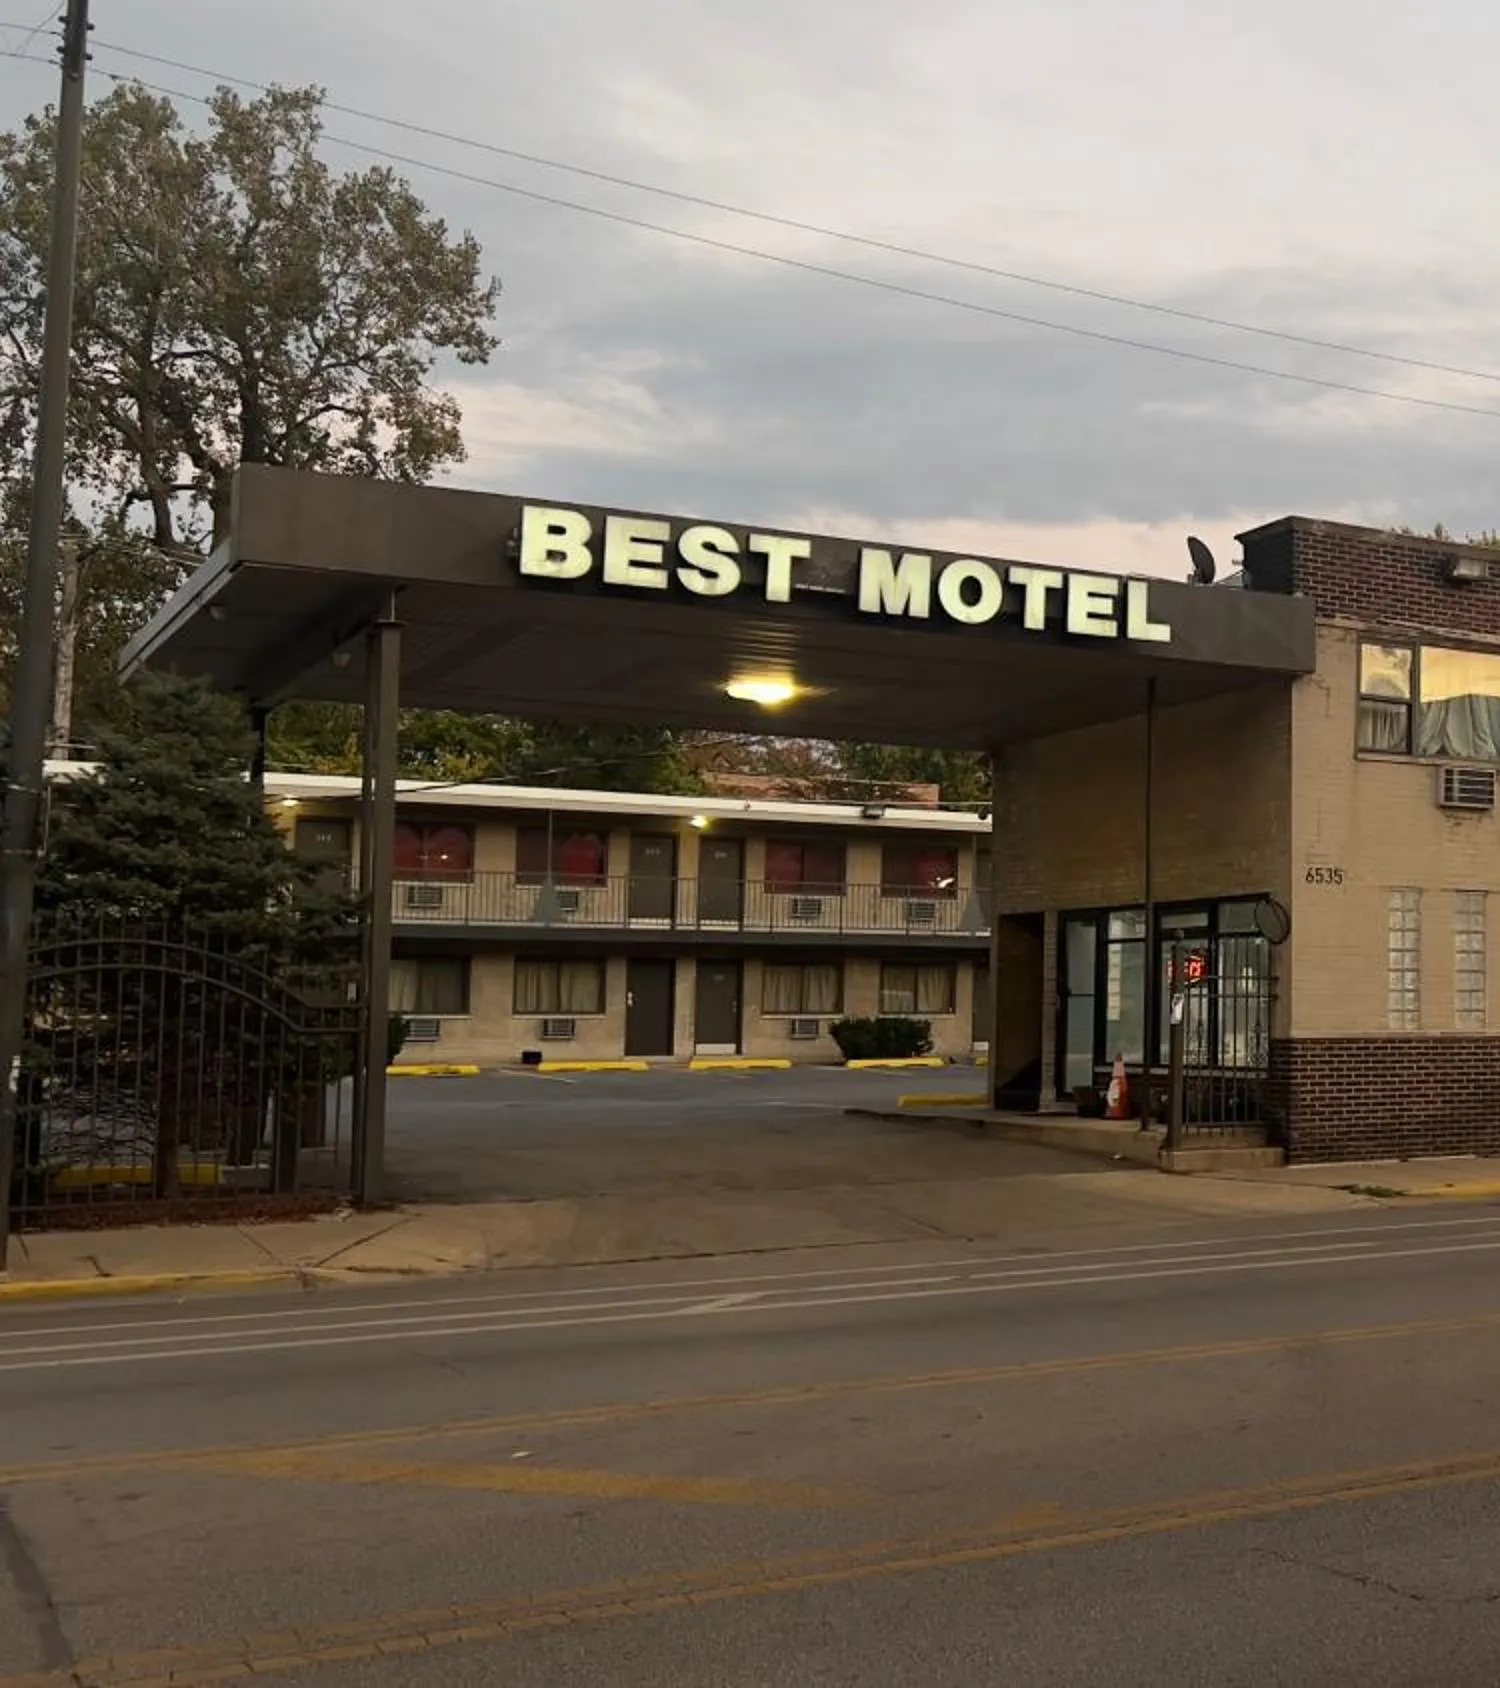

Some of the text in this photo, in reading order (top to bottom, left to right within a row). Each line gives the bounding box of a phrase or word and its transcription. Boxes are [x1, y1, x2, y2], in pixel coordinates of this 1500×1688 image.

[520, 504, 1171, 643] BEST MOTEL
[1305, 866, 1343, 885] 6535
